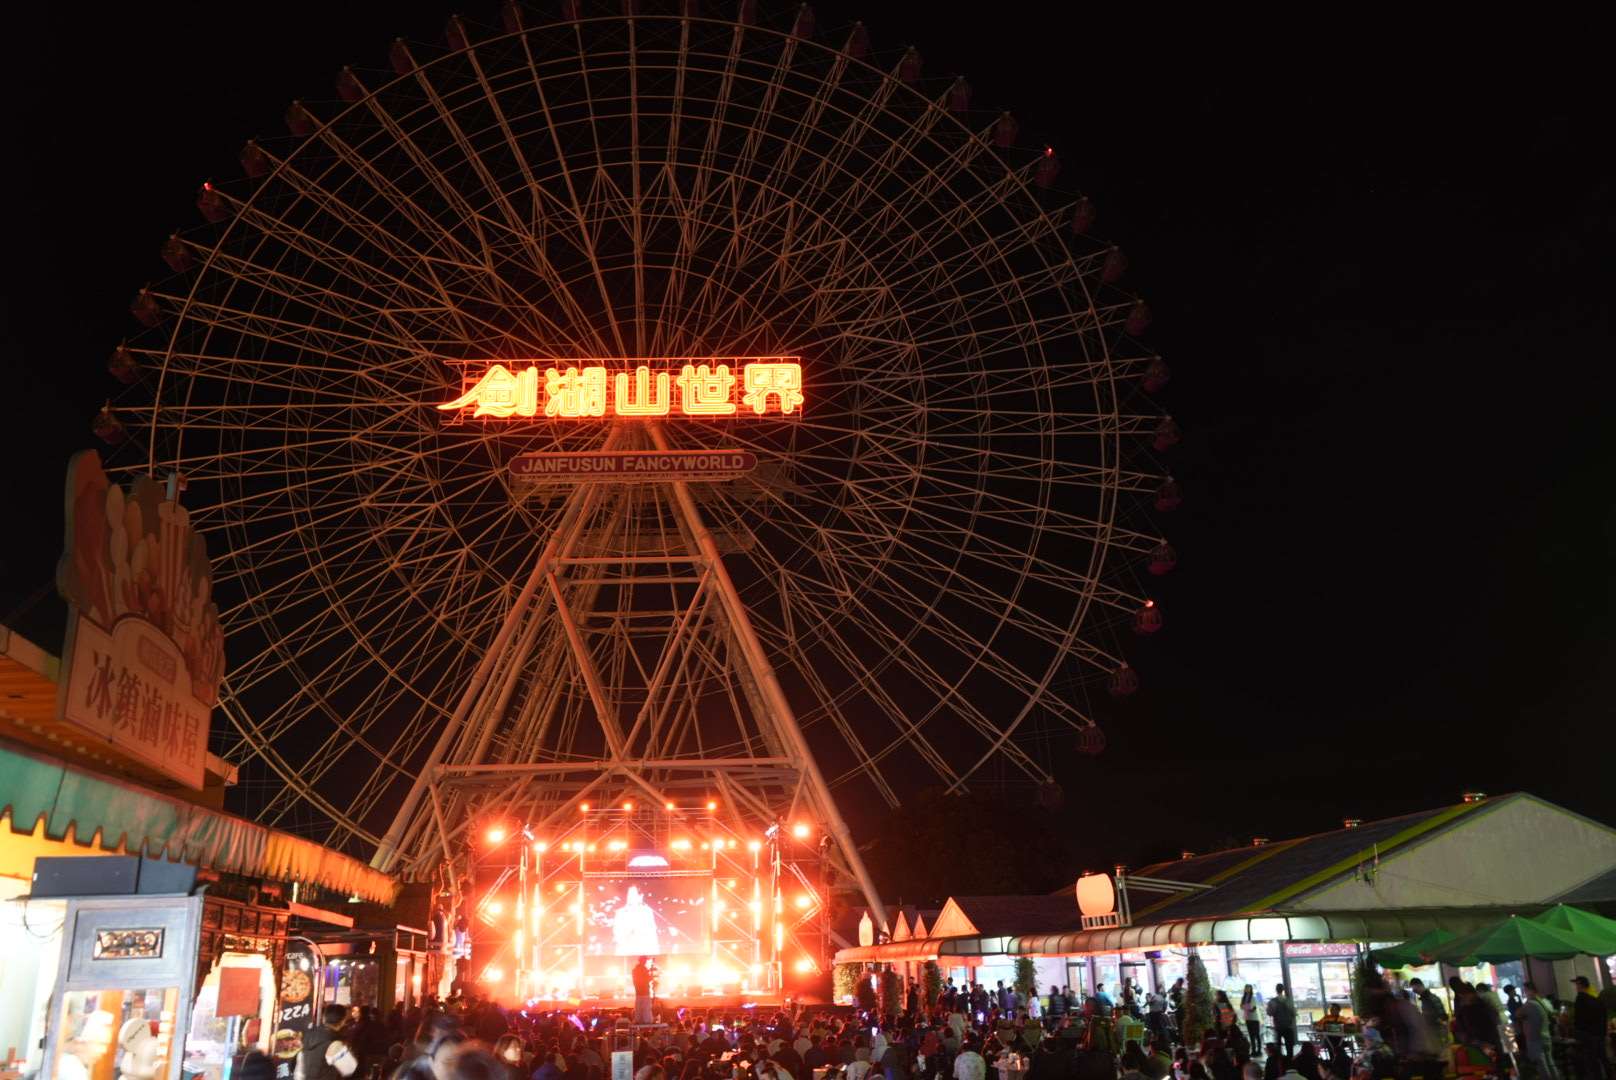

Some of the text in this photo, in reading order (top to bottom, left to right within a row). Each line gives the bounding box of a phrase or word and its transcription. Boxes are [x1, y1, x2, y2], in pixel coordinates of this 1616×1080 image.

[436, 363, 804, 418] 劍湖山世界
[521, 455, 745, 473] JANFUSUN FANCYWORLD
